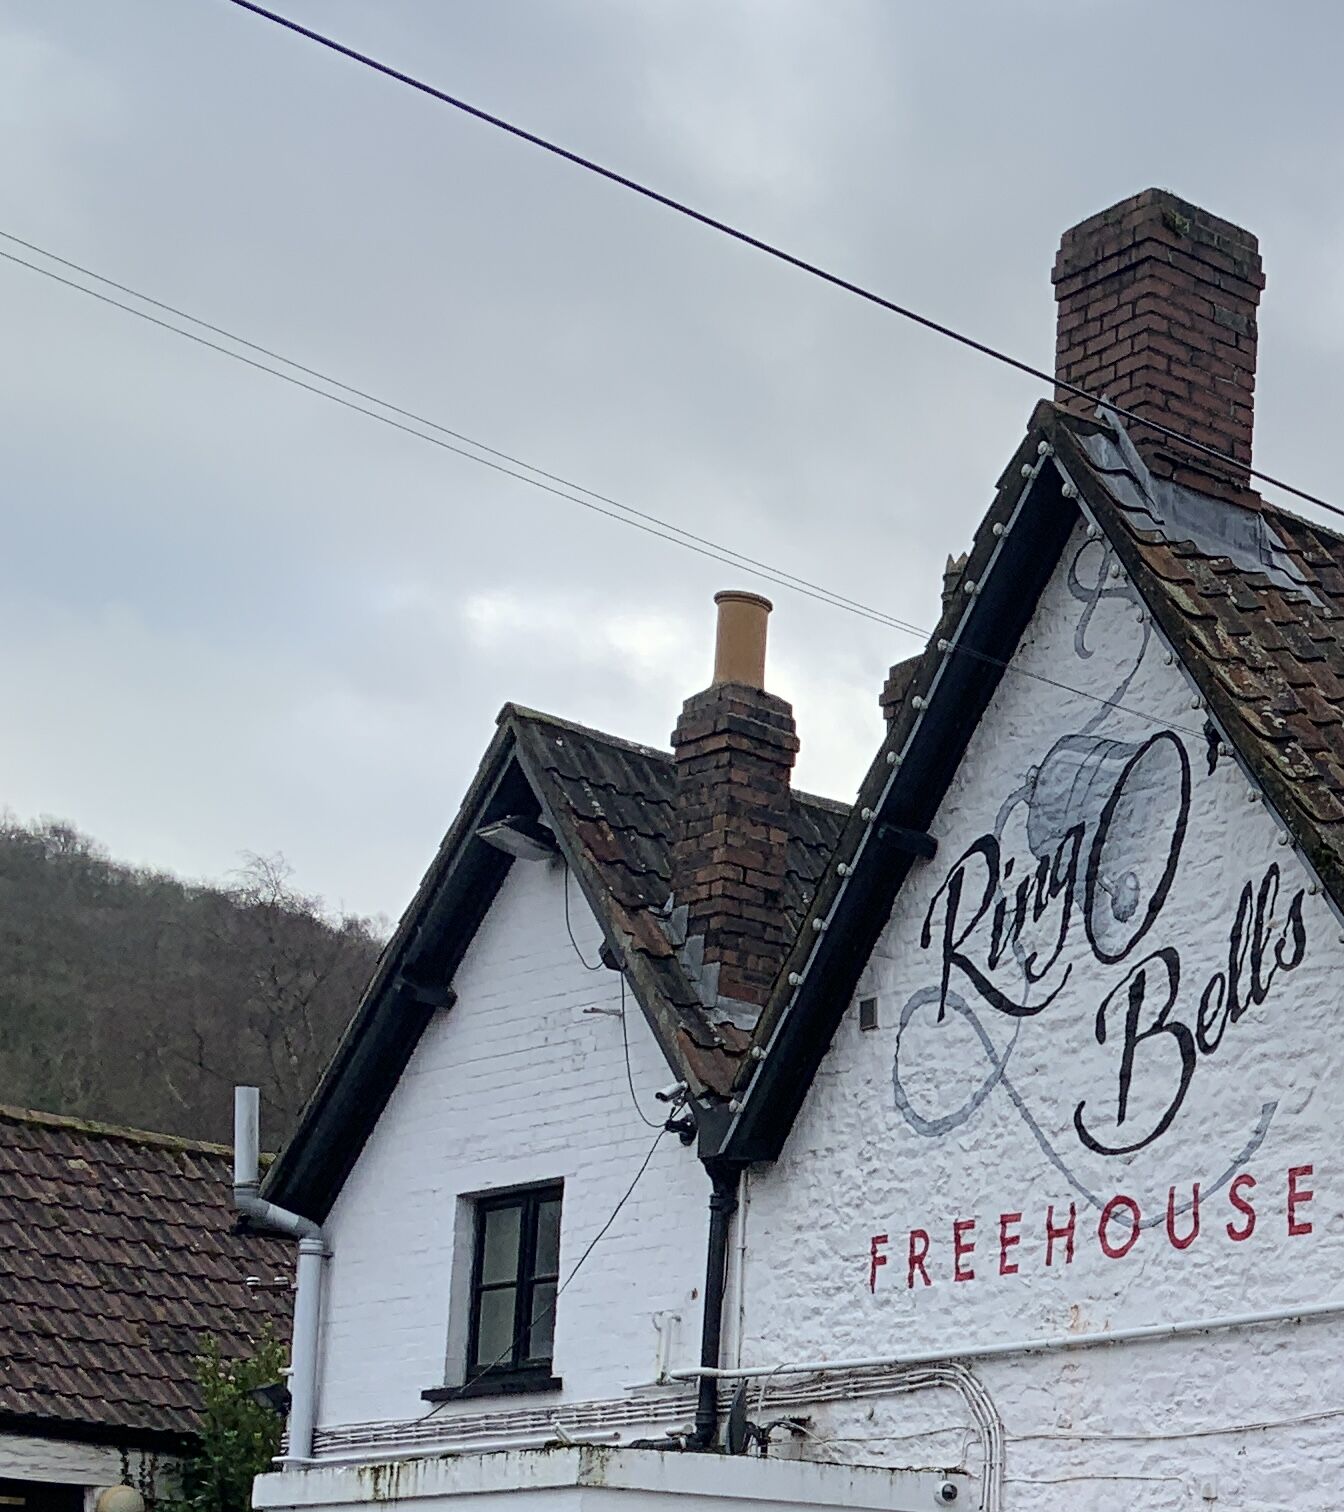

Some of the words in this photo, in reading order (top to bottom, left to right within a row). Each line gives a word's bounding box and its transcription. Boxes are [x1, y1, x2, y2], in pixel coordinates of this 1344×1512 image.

[920, 821, 1085, 1023] Ring
[1073, 862, 1306, 1156] Bells
[869, 1164, 1314, 1294] FREEHOUSE
